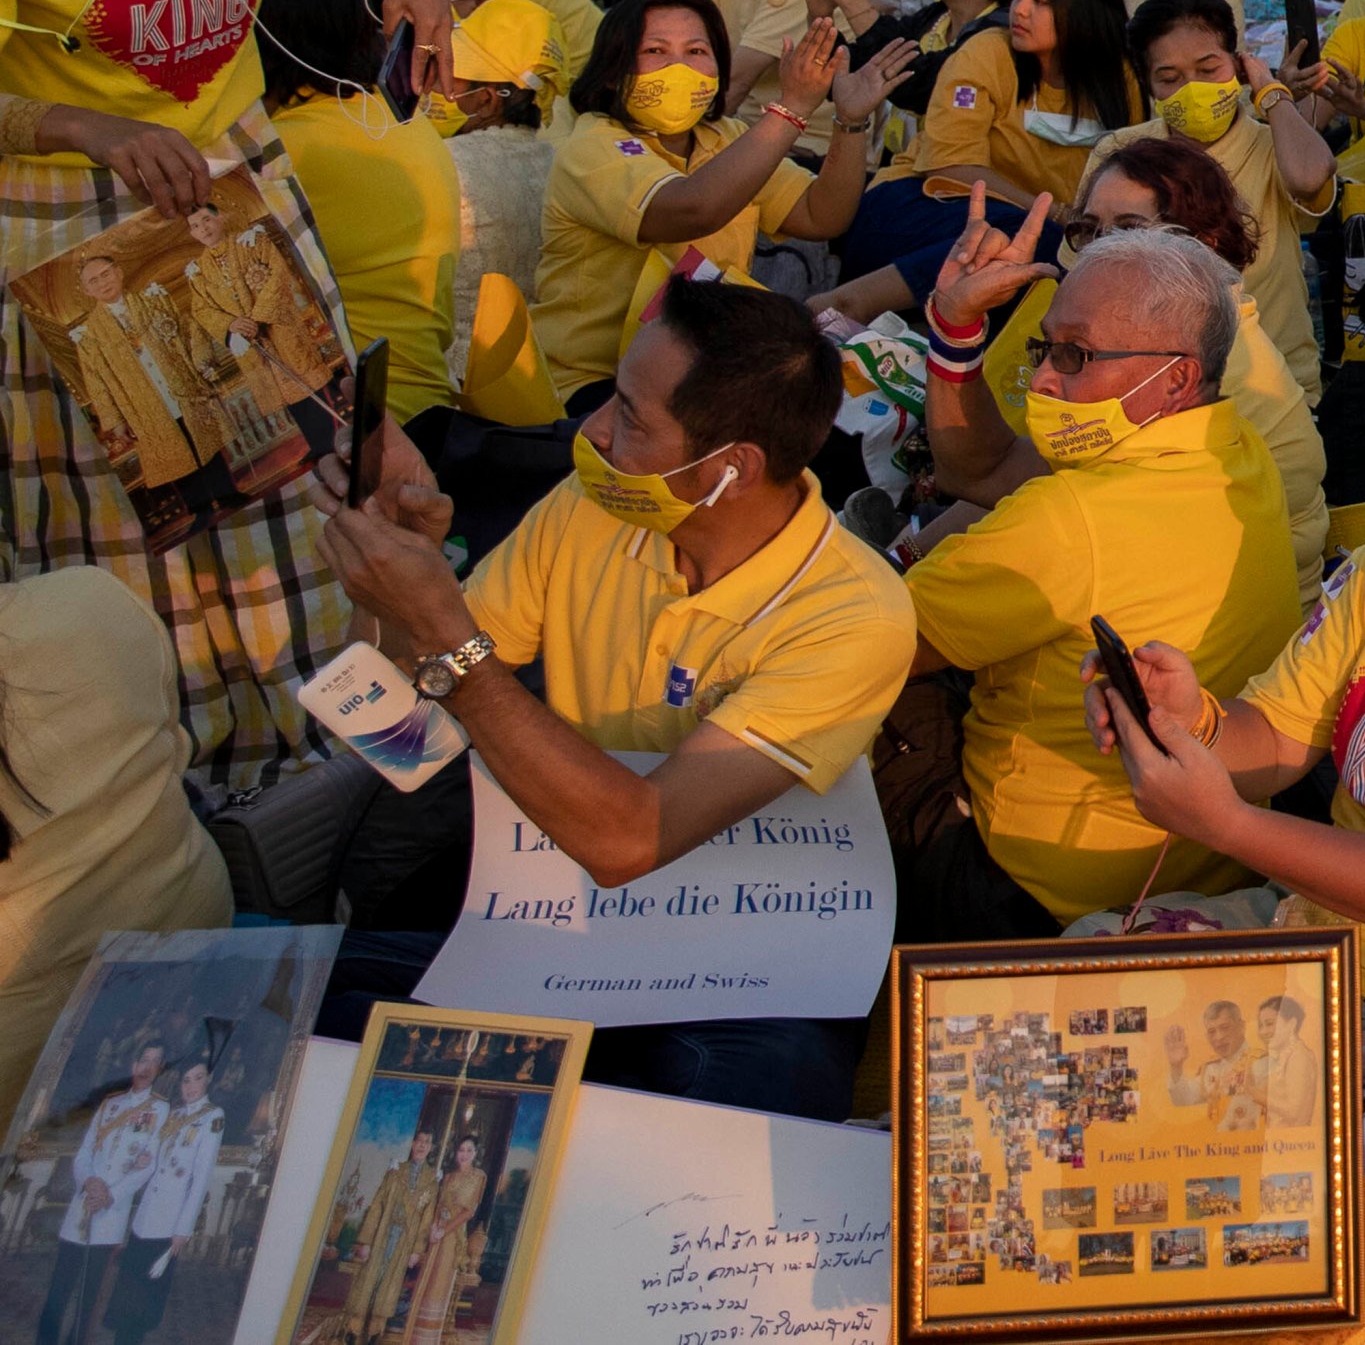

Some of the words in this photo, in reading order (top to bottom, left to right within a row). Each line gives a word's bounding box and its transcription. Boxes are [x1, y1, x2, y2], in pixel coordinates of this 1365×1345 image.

[133, 55, 167, 66] OF
[175, 26, 243, 64] HEARTS
[751, 817, 852, 852] König
[482, 892, 576, 927] Lang
[585, 888, 656, 918] lebe
[666, 884, 720, 915] die
[731, 880, 875, 921] Königin
[544, 973, 646, 991] German
[651, 973, 696, 990] and
[702, 971, 770, 989] Swiss
[1099, 1149, 1136, 1164] Long
[1139, 1147, 1171, 1161] Live
[1174, 1145, 1201, 1158] The
[1205, 1143, 1241, 1159] King
[1244, 1143, 1268, 1153] and
[1273, 1140, 1316, 1153] Queen
